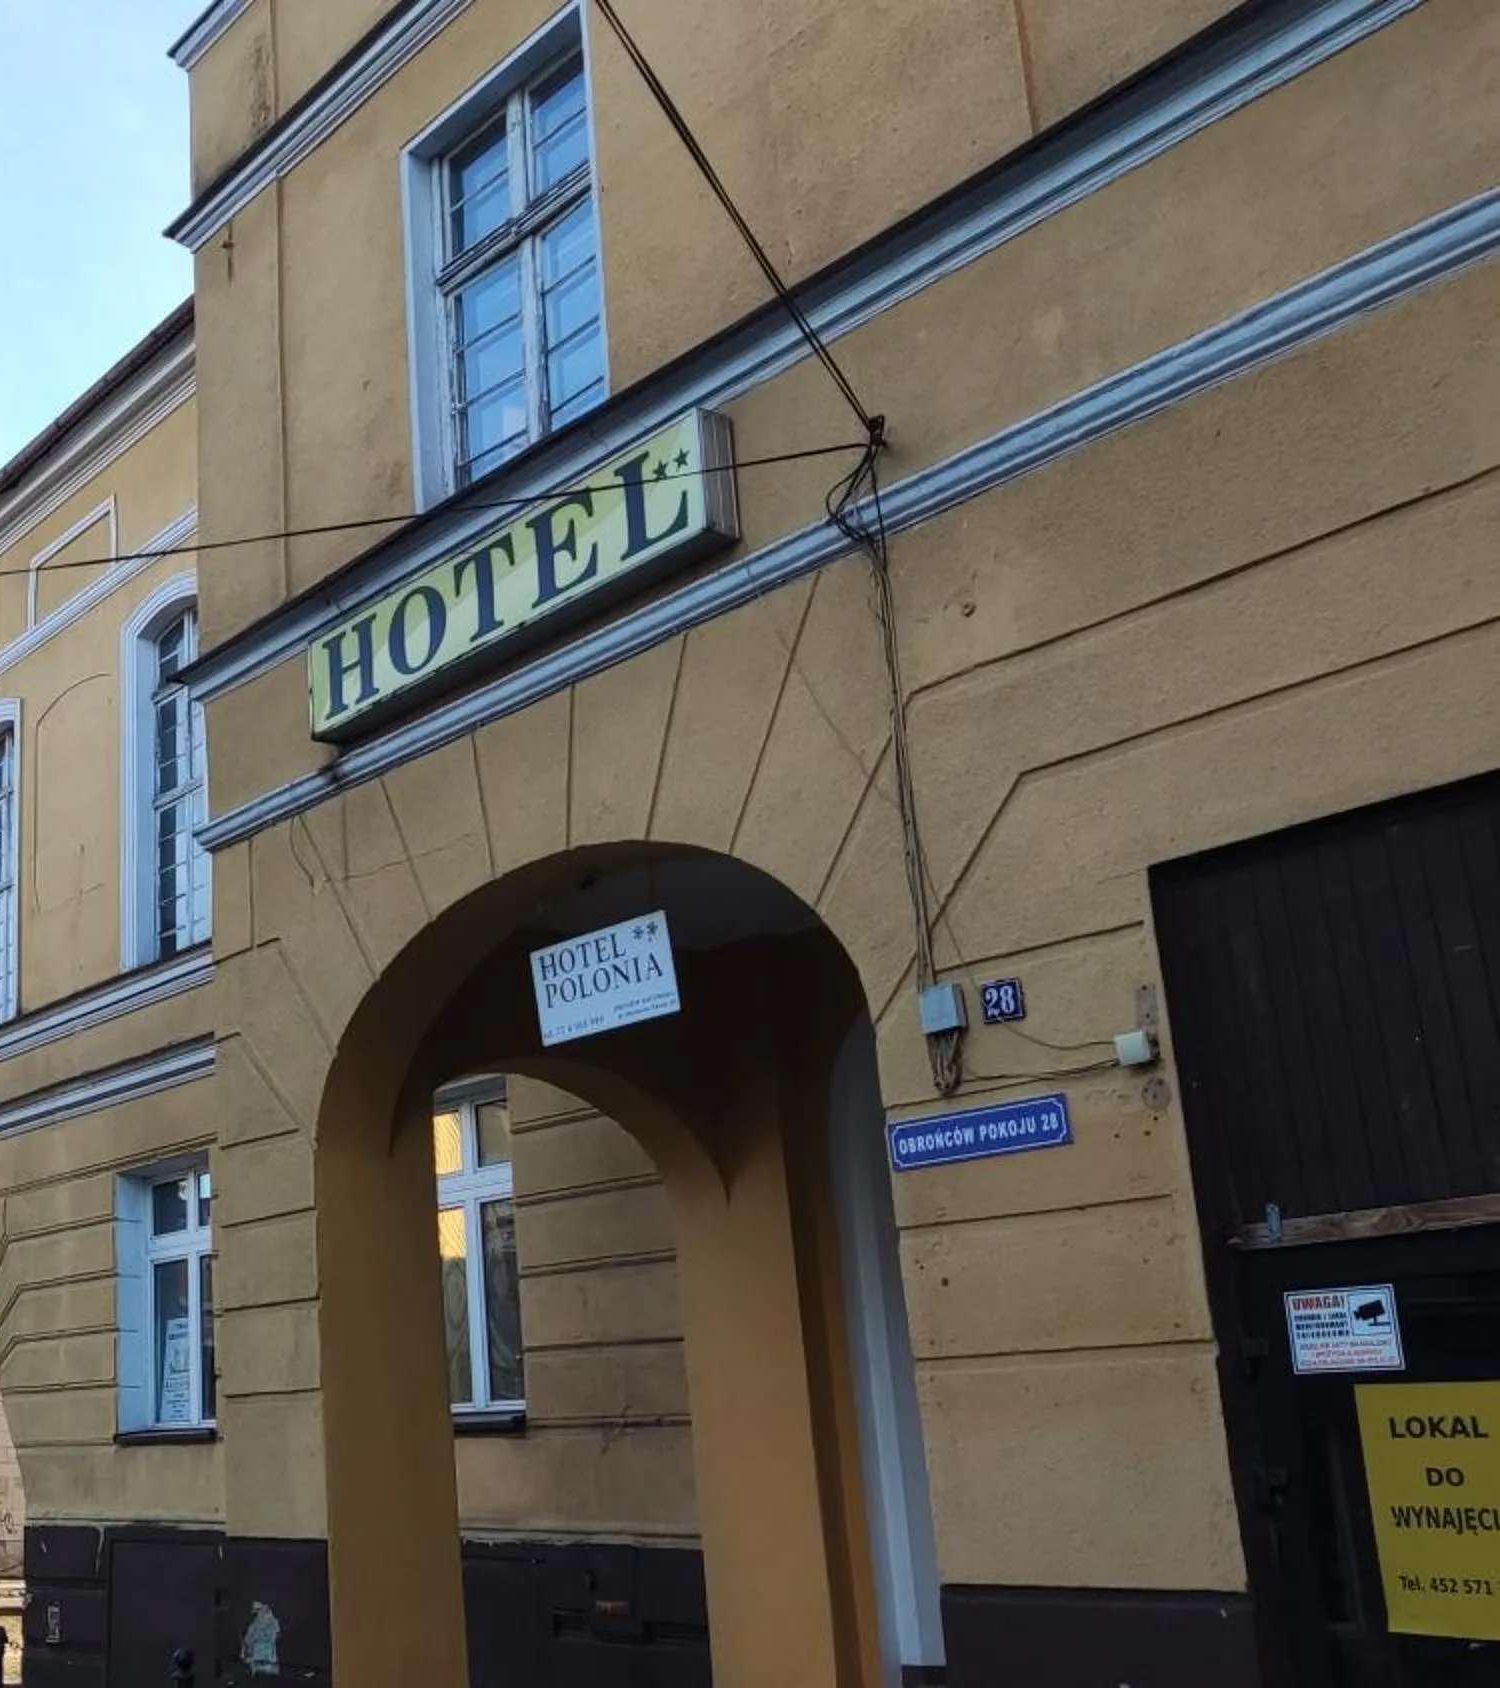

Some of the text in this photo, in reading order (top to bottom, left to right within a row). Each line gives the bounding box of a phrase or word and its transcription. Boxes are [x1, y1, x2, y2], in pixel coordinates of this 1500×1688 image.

[322, 450, 690, 720] HOTEL
[539, 932, 627, 981] HOTEL
[545, 952, 663, 1009] POLONIA
[985, 985, 1015, 1018] 28
[899, 1112, 1060, 1155] OBROŃCÓW POKOJU 28
[1388, 1416, 1489, 1439] LOKAL
[1425, 1466, 1465, 1487] DO
[1389, 1505, 1500, 1536] WYNAJĘCI
[1398, 1575, 1493, 1596] Tel. 452 571
